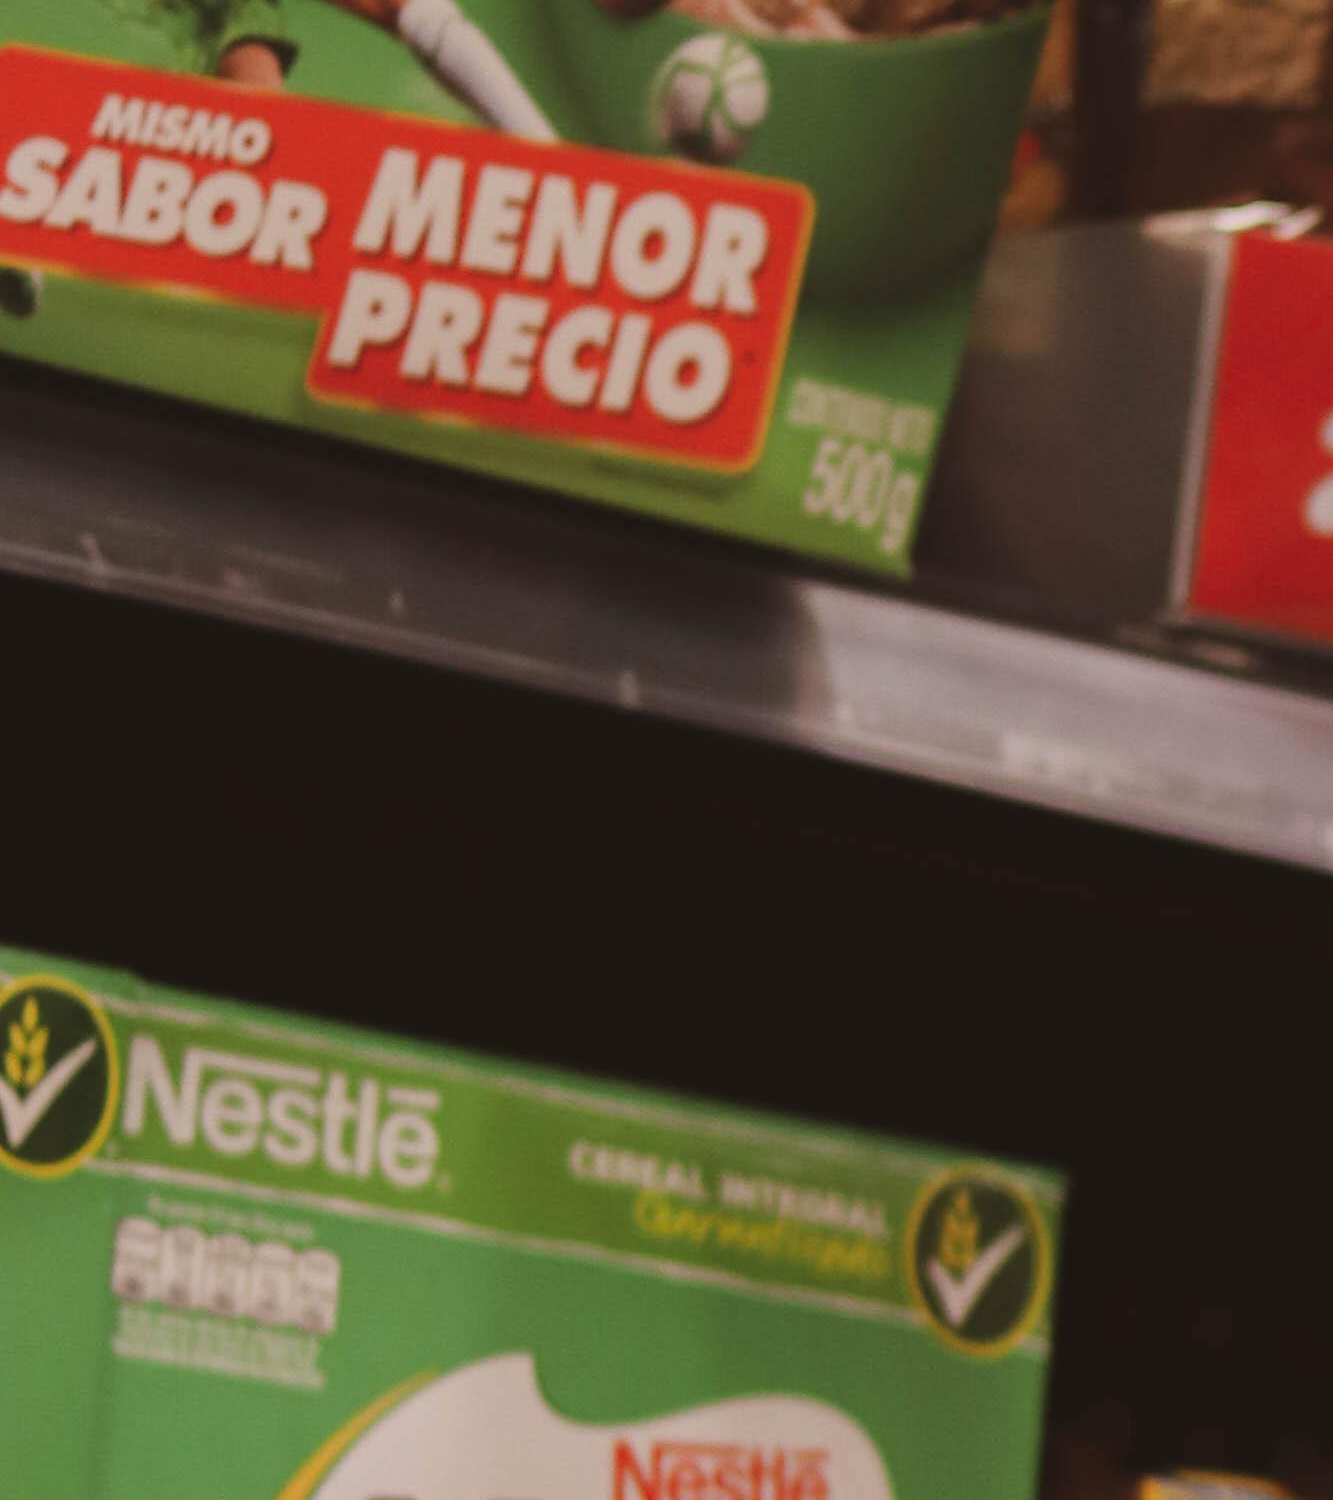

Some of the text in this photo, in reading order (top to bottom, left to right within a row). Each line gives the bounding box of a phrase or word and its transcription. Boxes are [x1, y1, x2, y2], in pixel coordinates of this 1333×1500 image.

[91, 93, 271, 166] MISMO
[0, 137, 328, 271] SABOR
[352, 146, 770, 314] MENOR
[327, 269, 732, 424] PRECIO
[122, 1033, 442, 1190] Nestlé
[570, 1140, 887, 1238] CEREAL INTEGRAL
